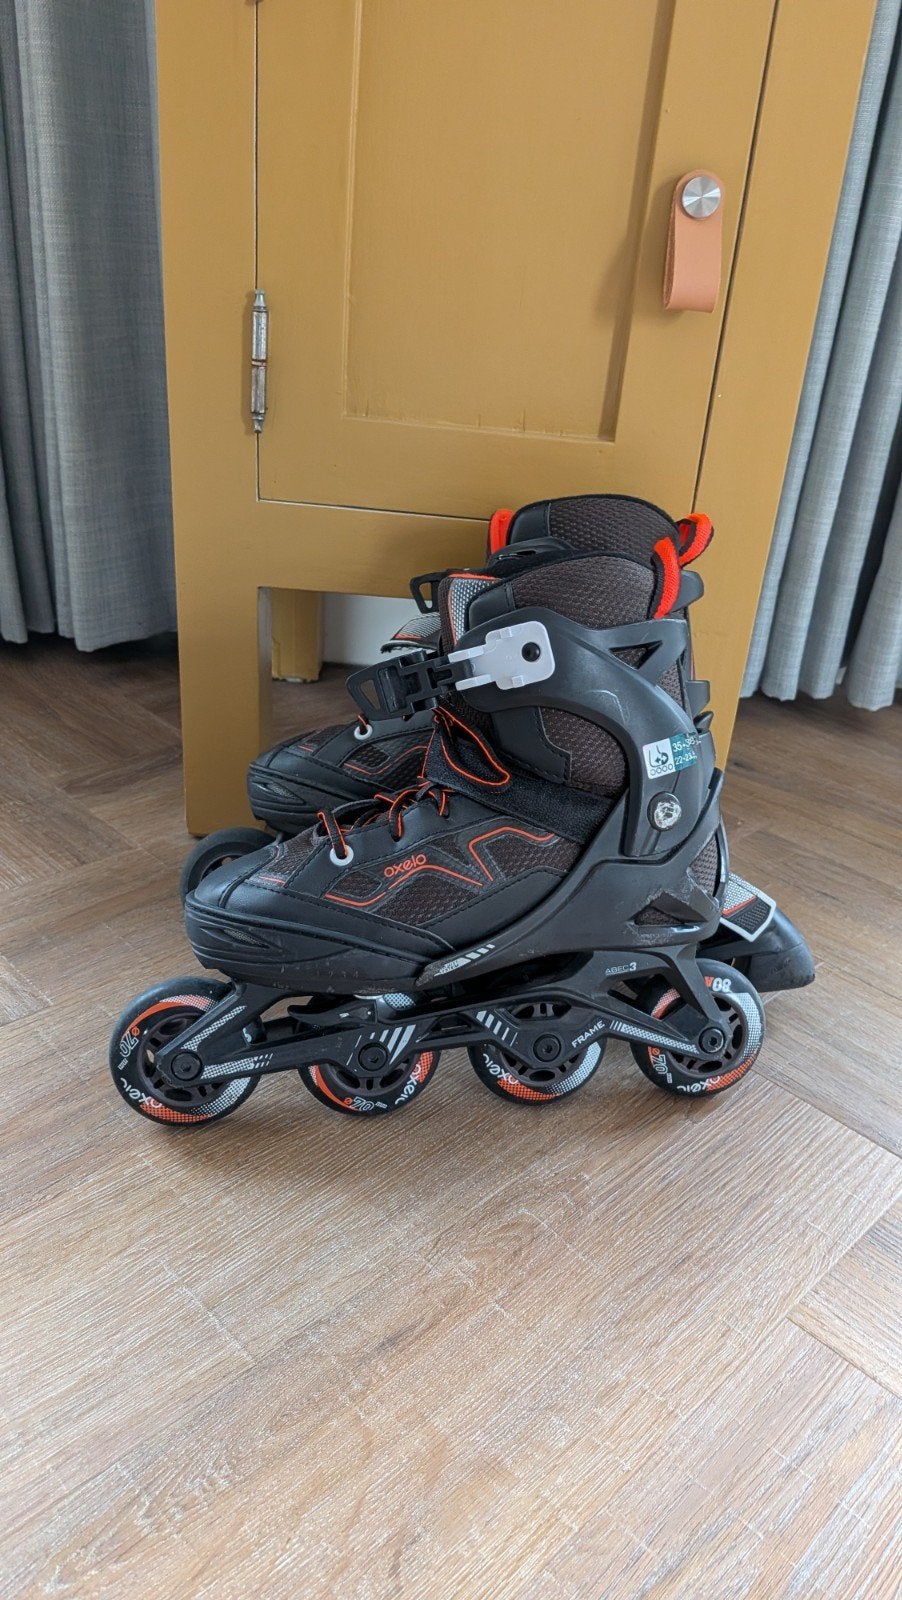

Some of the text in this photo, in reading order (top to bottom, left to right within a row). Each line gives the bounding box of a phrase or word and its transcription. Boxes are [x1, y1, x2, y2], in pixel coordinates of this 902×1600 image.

[383, 853, 427, 878] oxelo
[704, 975, 732, 993] 80A
[571, 1020, 606, 1048] FRAME
